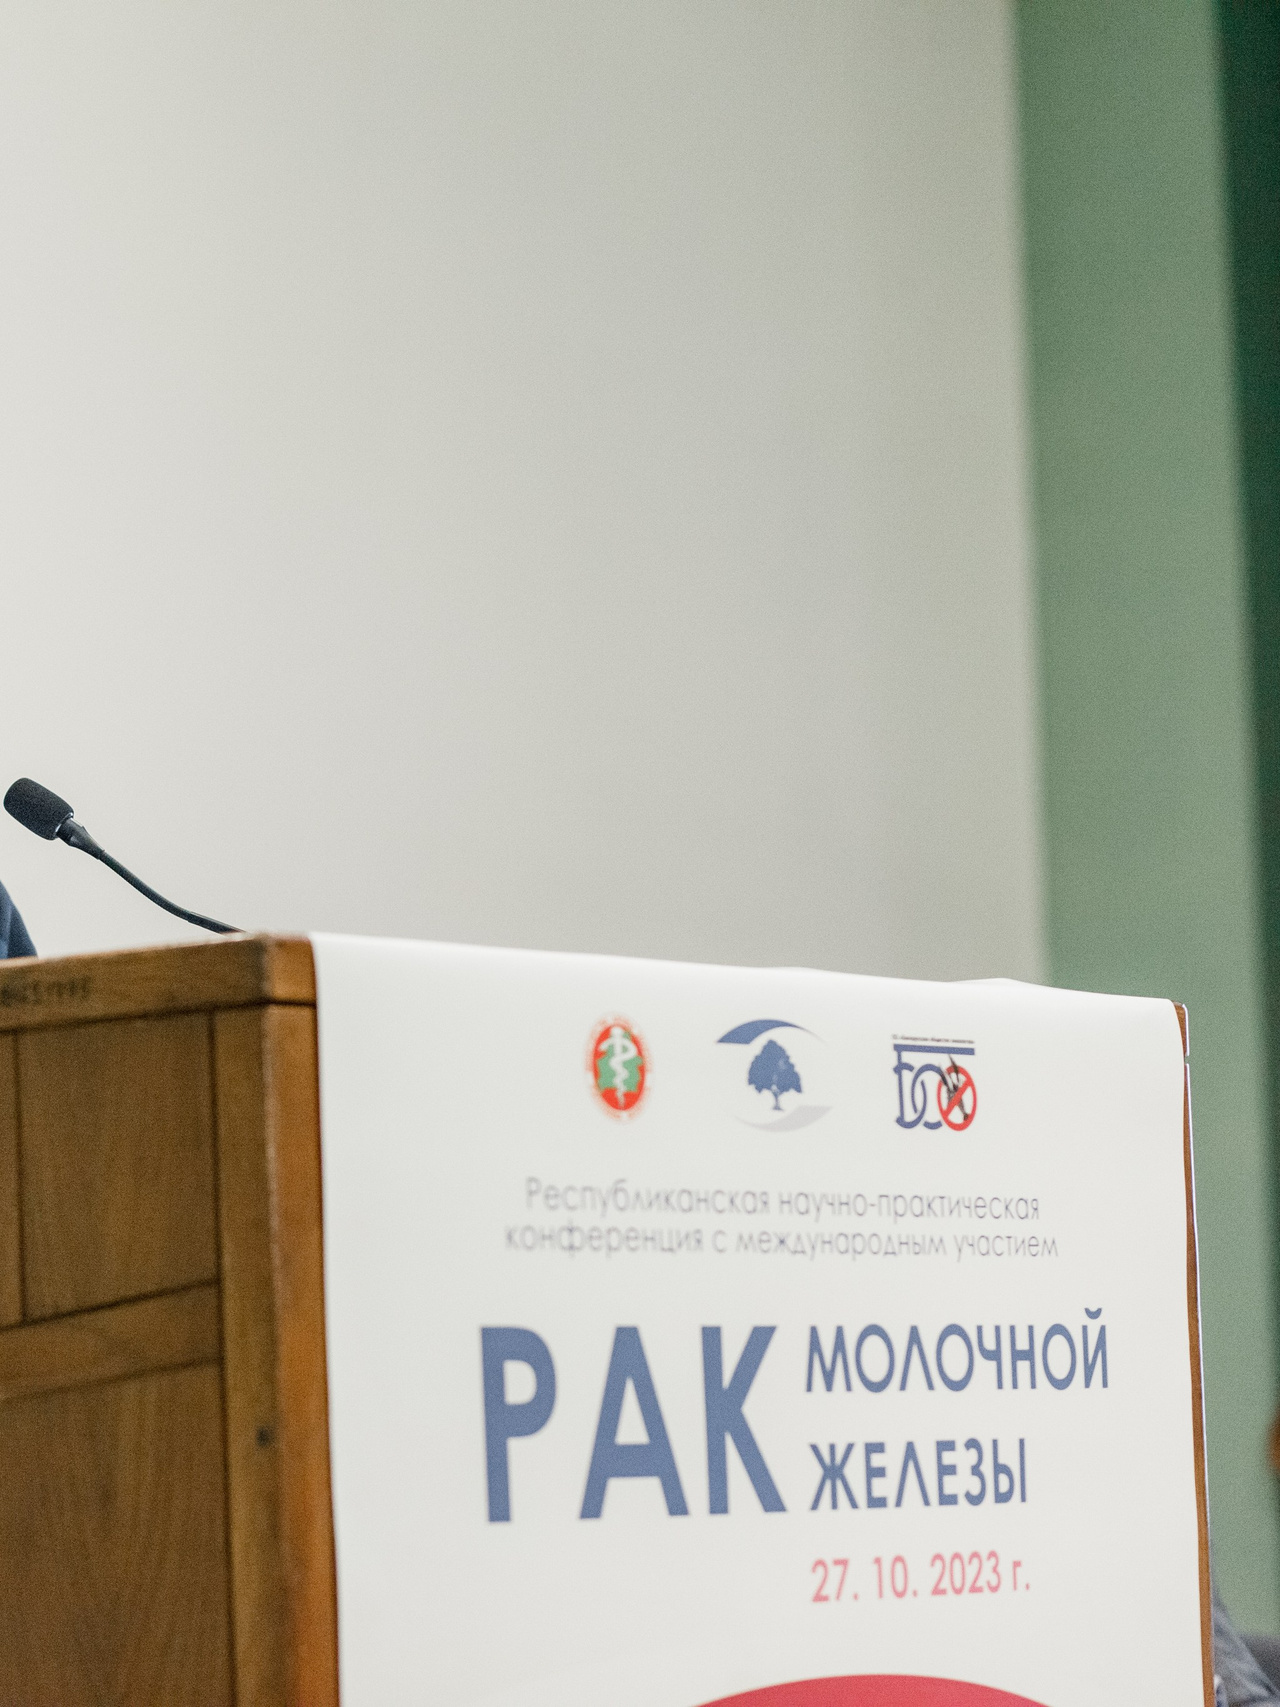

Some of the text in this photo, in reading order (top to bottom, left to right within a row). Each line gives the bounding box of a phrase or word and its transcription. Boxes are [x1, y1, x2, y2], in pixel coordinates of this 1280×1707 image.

[524, 1177, 1040, 1224] Республиканская научно-практическая
[504, 1220, 1059, 1262] конференция с международным участием
[805, 1307, 1109, 1394] МОЛОЧНОЙ
[478, 1324, 788, 1524] РАК
[808, 1437, 1027, 1512] ЖЕЛЕЗЫ
[810, 1550, 1032, 1604] 27. 10. 2023 г.
